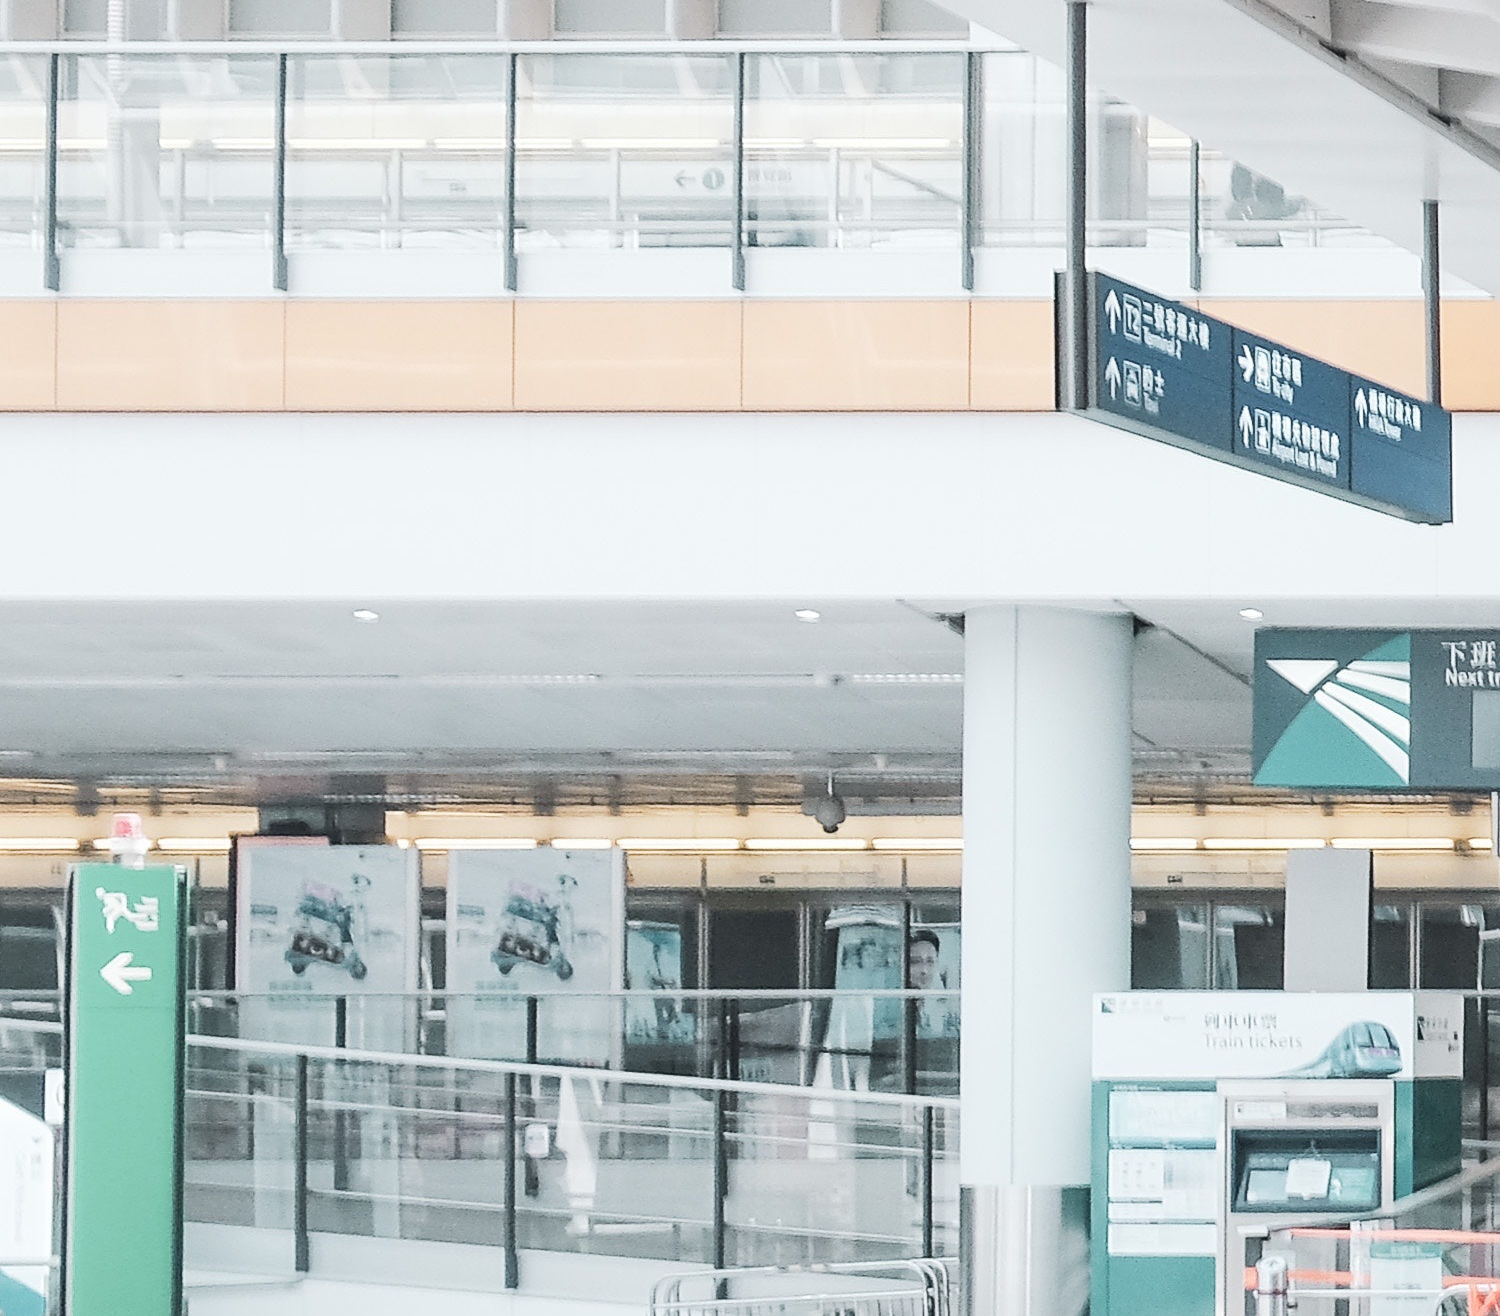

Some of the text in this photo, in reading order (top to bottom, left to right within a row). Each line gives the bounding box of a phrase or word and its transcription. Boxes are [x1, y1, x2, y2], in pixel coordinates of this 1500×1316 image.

[1445, 667, 1483, 687] Next
[1203, 1032, 1304, 1050] Train tickets
